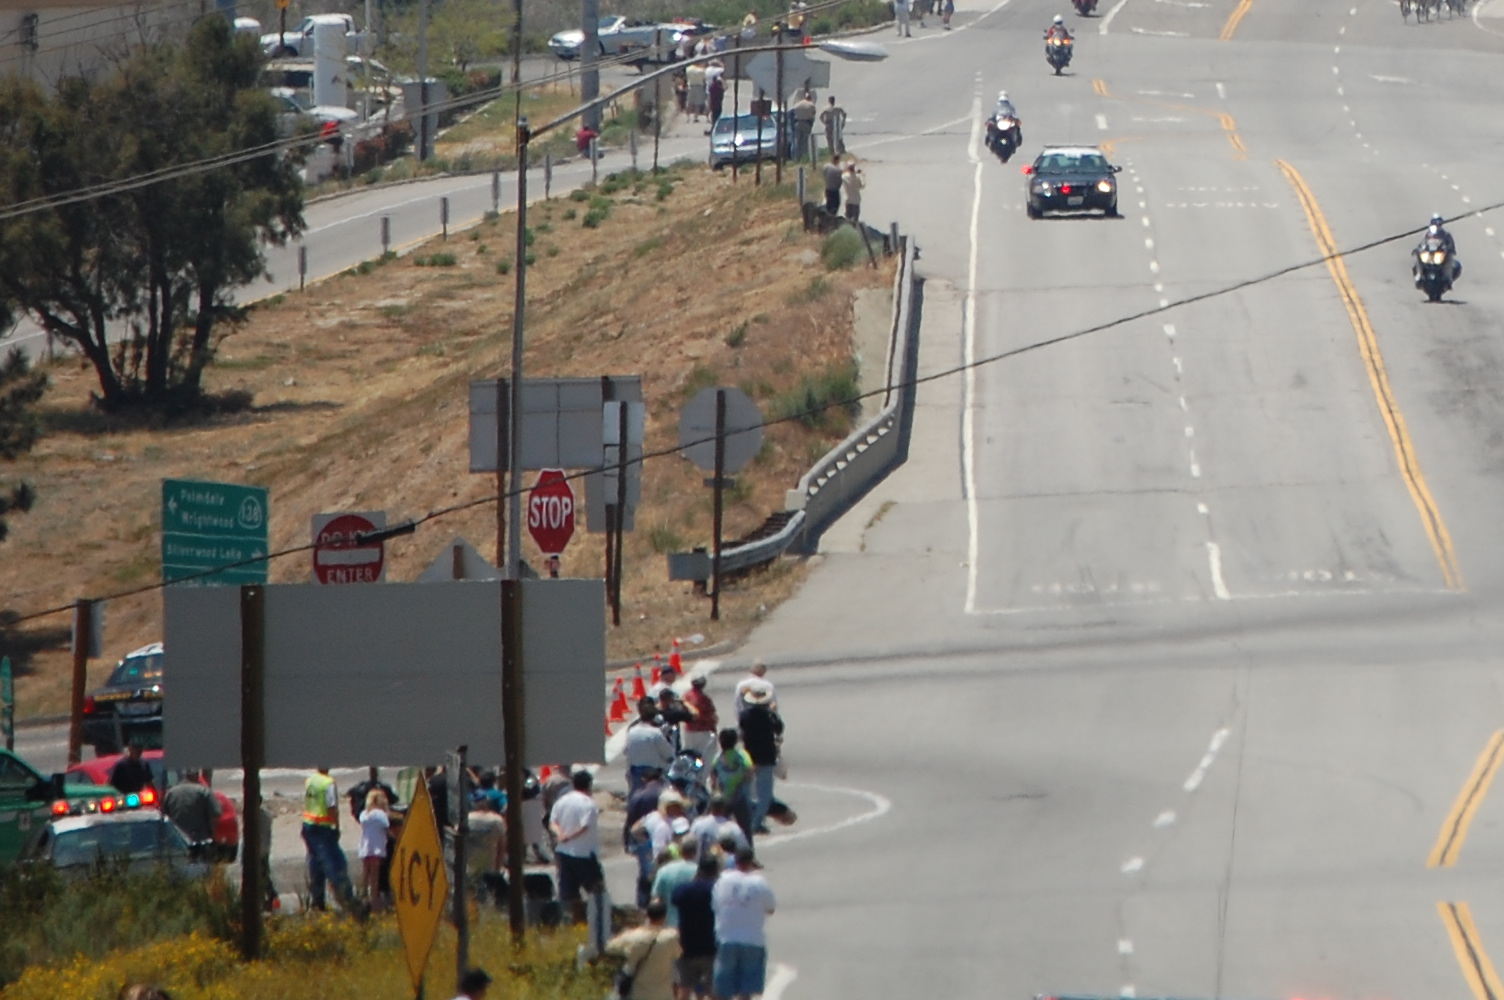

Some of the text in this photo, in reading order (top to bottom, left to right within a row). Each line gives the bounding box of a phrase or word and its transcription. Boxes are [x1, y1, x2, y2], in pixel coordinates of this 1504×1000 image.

[180, 488, 225, 507] Palmdale
[181, 512, 235, 530] Wrightwood
[241, 505, 259, 523] 138
[530, 495, 572, 529] STOP
[219, 546, 243, 561] Lake
[326, 567, 374, 585] ENTER
[400, 847, 440, 911] ICY
